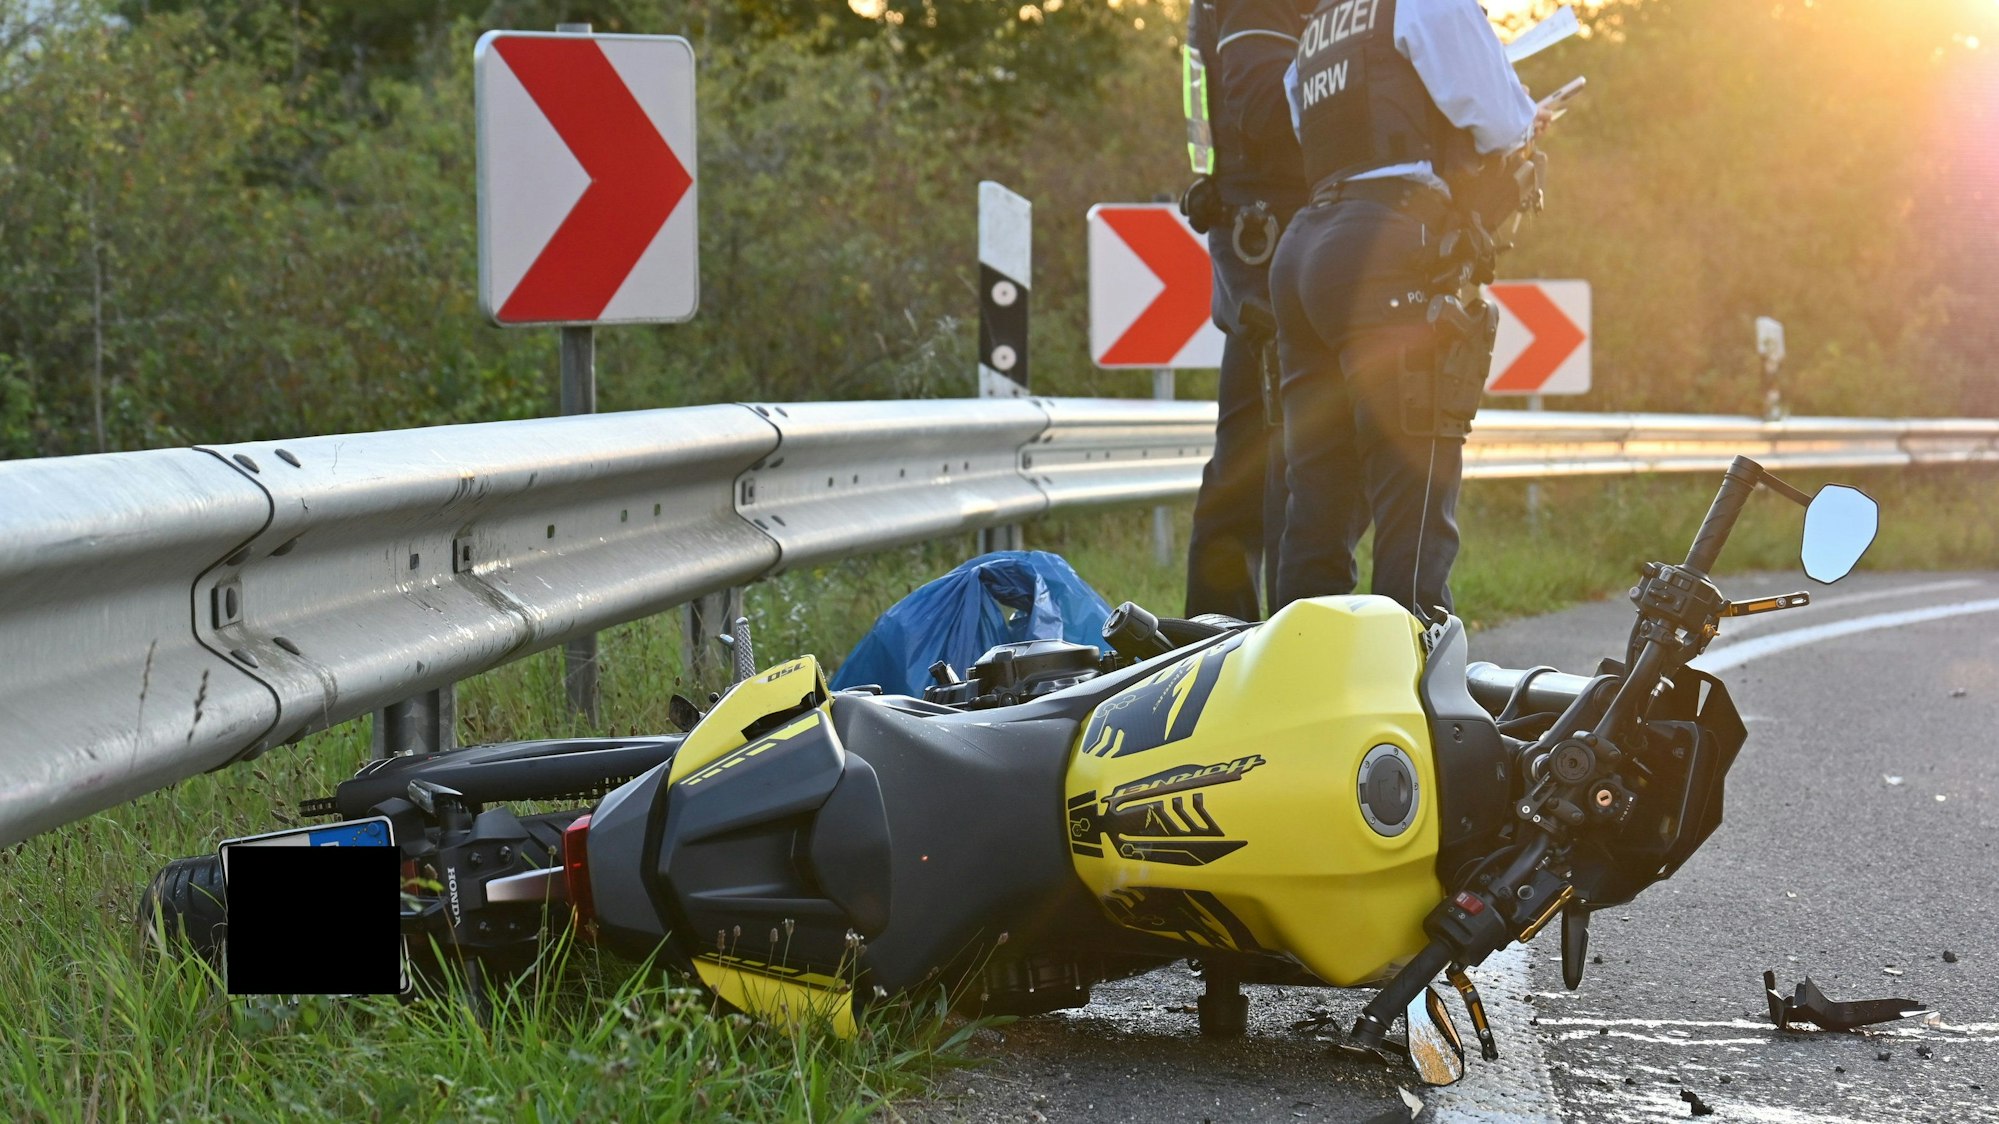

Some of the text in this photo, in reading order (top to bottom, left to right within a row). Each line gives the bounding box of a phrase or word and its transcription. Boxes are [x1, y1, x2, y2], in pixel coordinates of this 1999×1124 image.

[1303, 59, 1348, 110] NRW
[1407, 289, 1427, 304] PO
[767, 663, 806, 683] 750
[447, 867, 461, 929] HONDA
